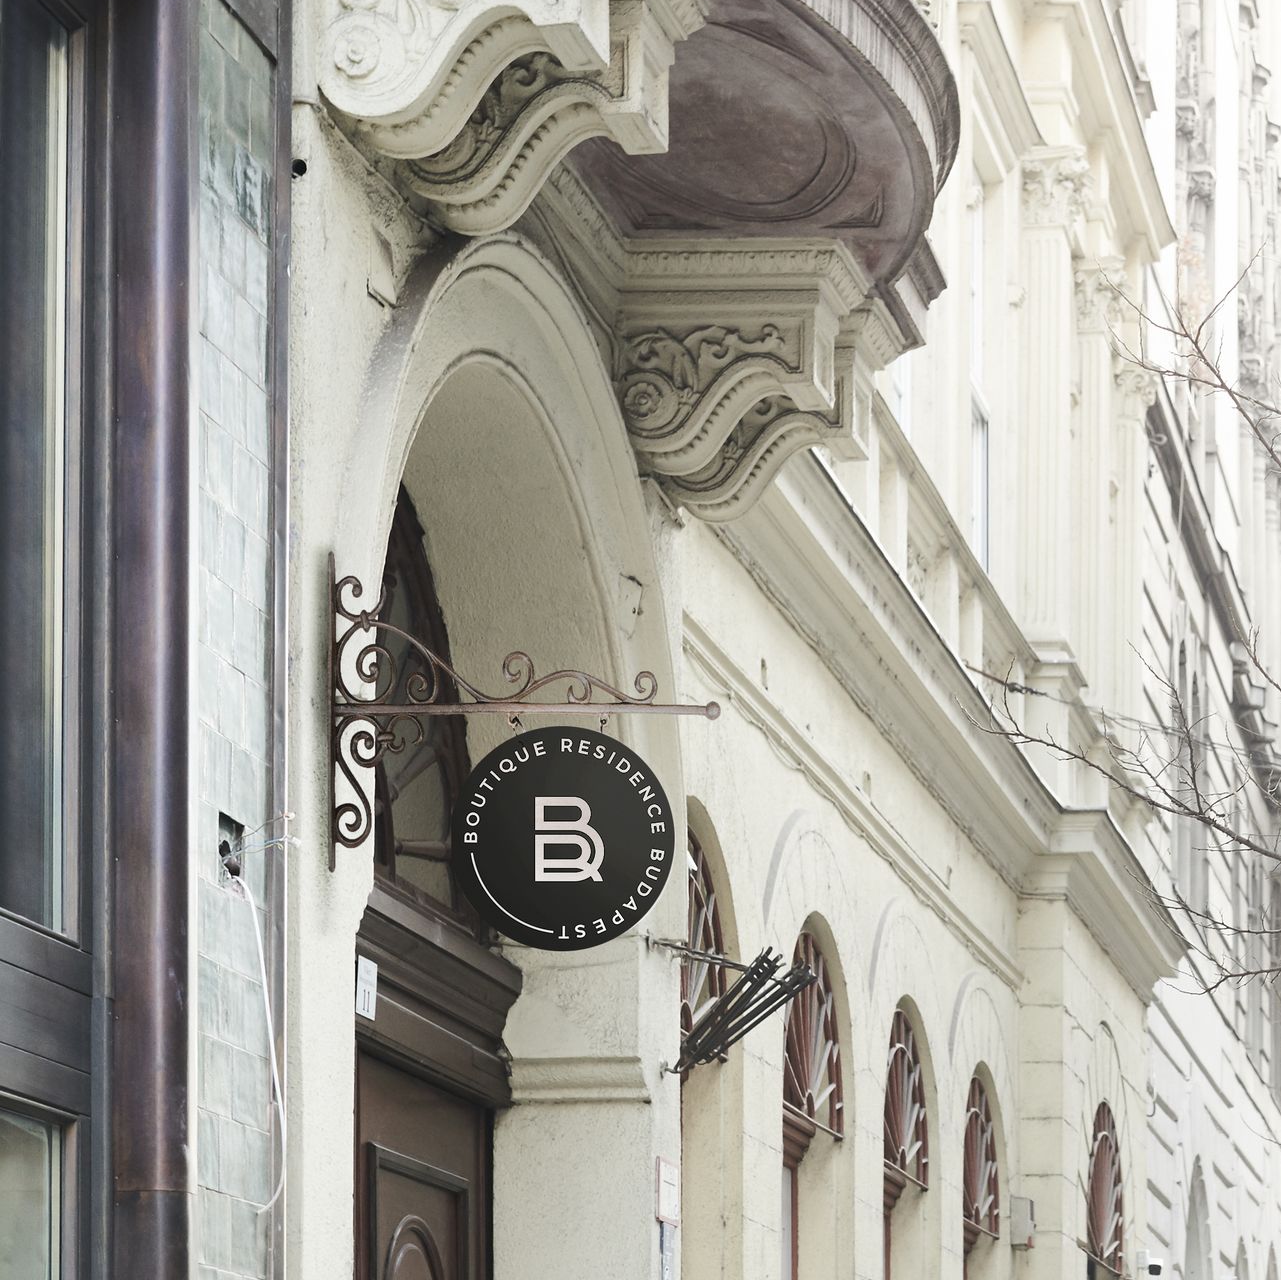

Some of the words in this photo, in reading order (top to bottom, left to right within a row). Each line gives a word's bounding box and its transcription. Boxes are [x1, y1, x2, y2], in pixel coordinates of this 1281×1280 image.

[464, 741, 547, 844] BOUTIQUE
[560, 738, 666, 834] RESIDENCE
[558, 848, 665, 939] BUDAPEST
